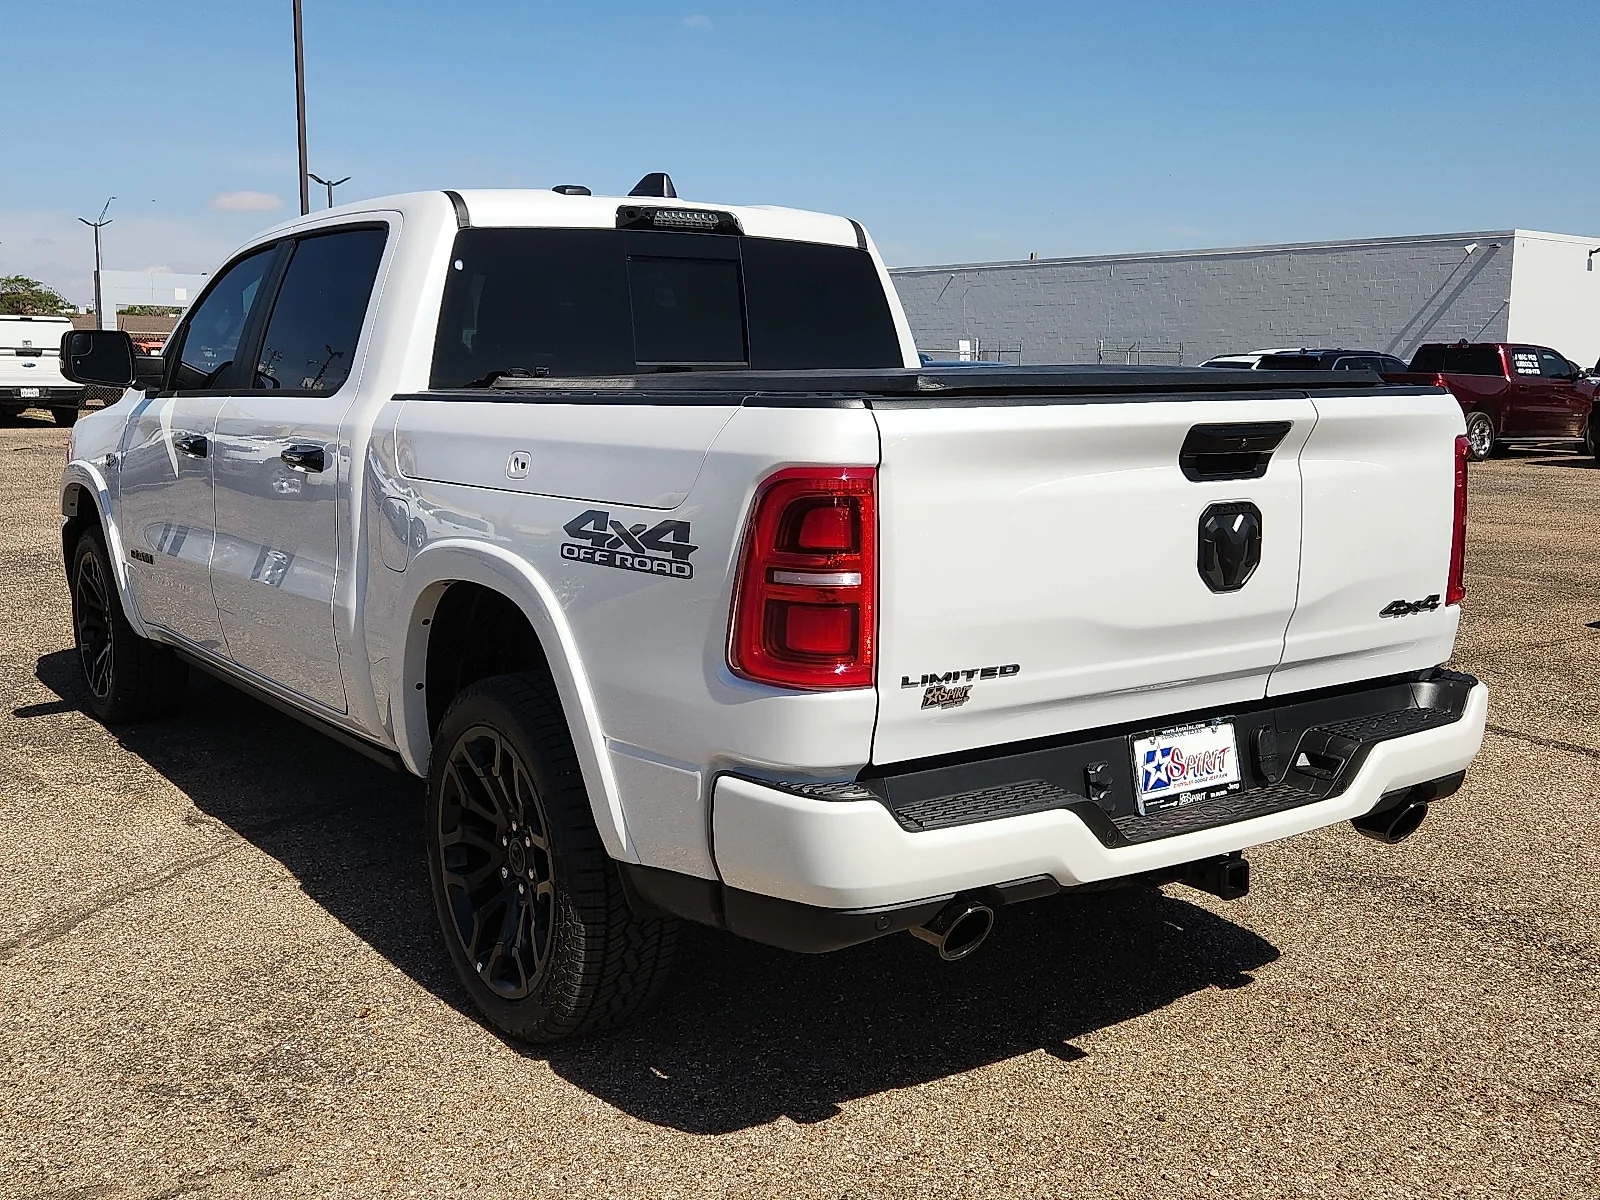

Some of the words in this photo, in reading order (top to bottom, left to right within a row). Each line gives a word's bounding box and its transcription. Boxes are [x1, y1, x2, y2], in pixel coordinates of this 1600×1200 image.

[562, 545, 611, 563] OFF
[615, 553, 691, 577] ROAD
[901, 663, 1020, 687] LIMITED
[1169, 746, 1231, 780] SPIRIT
